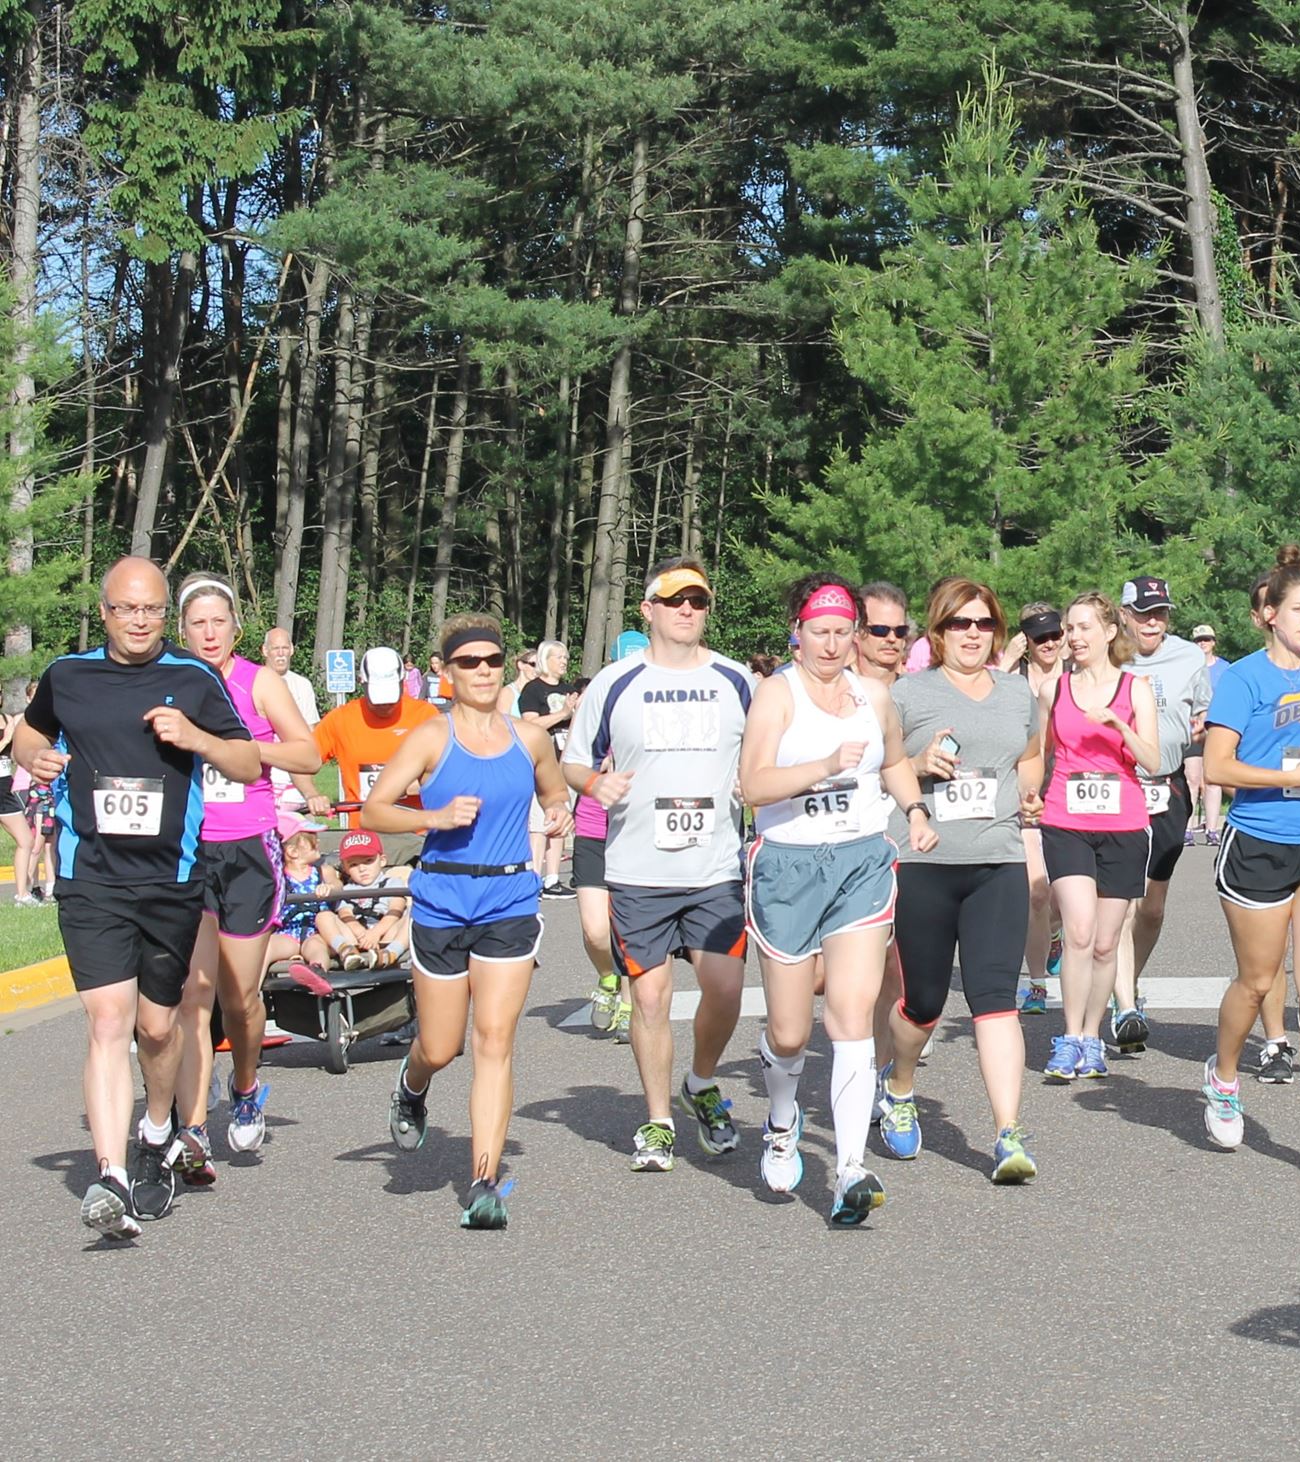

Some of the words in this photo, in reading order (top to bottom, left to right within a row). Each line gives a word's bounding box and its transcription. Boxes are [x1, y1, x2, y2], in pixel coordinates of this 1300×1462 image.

[644, 689, 719, 703] OAKDALE
[946, 781, 988, 803] 602
[1076, 783, 1111, 800] 606
[103, 793, 149, 817] 605
[804, 794, 850, 818] 615
[666, 811, 704, 832] 603
